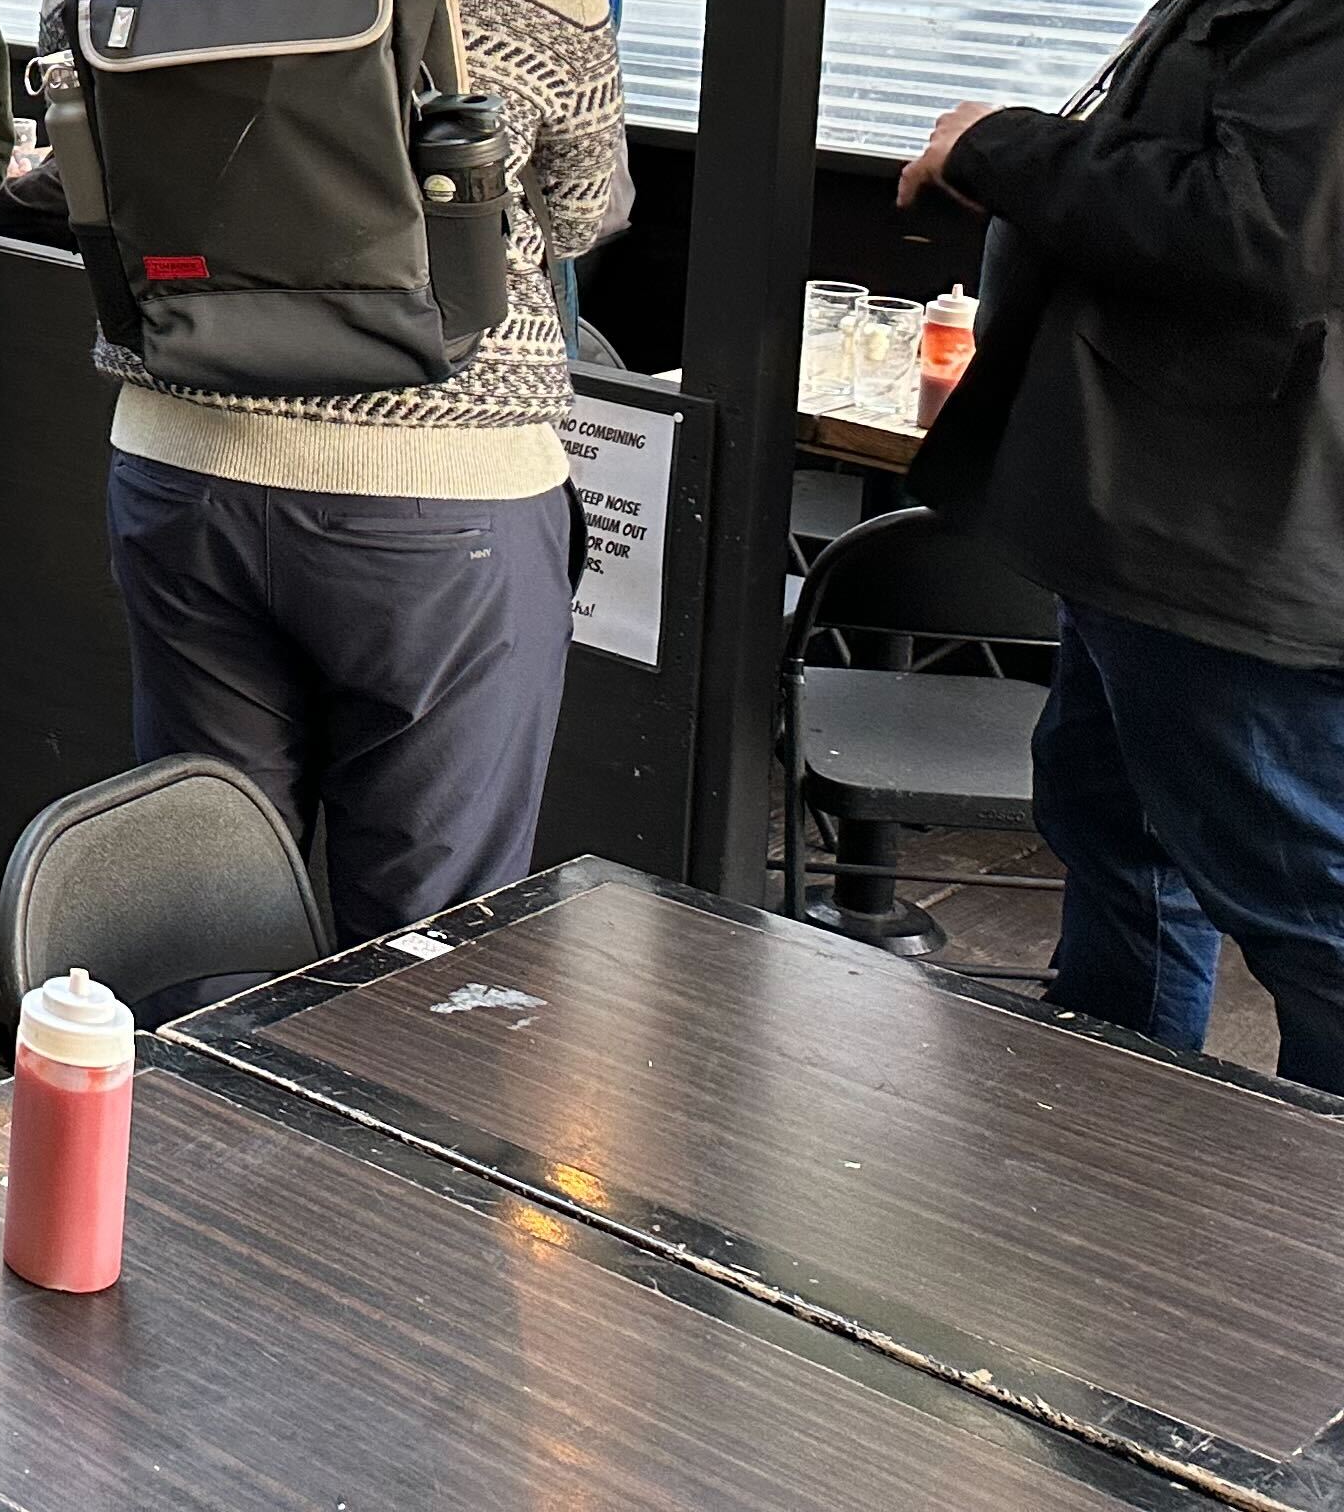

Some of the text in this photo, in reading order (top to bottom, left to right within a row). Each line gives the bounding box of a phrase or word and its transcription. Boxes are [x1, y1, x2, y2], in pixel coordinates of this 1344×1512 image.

[559, 417, 646, 449] NO COMBINING
[560, 438, 599, 460] TABLES
[605, 495, 642, 517] NOISE
[622, 522, 648, 541] OUT
[605, 541, 631, 559] OUR
